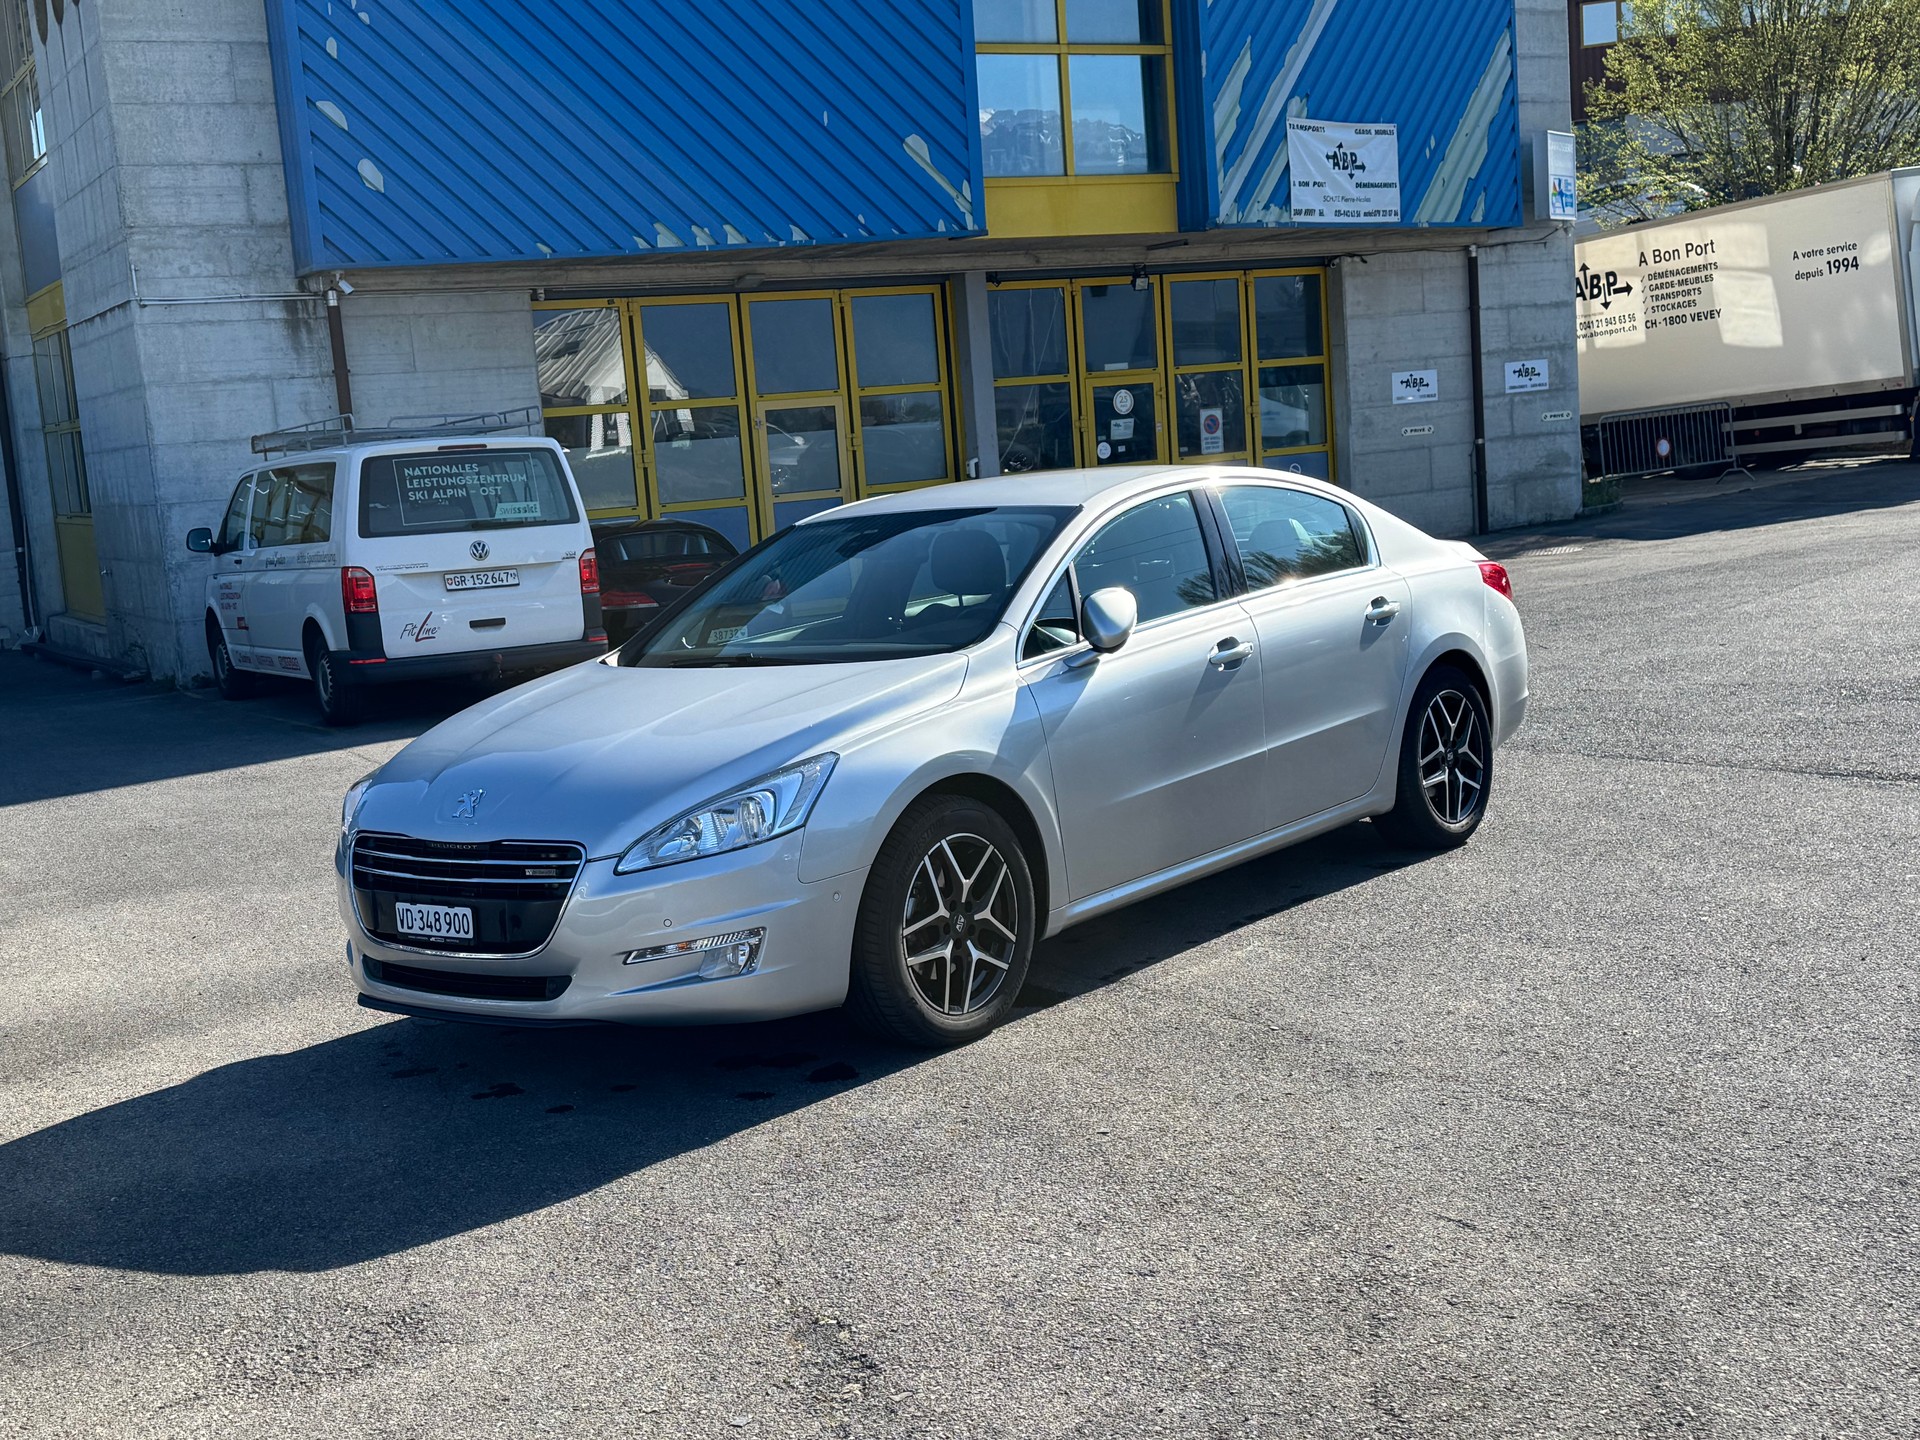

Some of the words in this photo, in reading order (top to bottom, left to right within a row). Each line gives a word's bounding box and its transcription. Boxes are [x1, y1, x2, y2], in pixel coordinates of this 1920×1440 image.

[1332, 151, 1358, 170] ABP
[1639, 251, 1648, 267] A
[1652, 248, 1680, 264] Bon
[1685, 239, 1715, 258] Port
[1793, 251, 1799, 261] A
[1801, 249, 1824, 259] votre
[1826, 241, 1857, 254] service
[1648, 262, 1718, 281] DÉMÉNAGEMENTS
[1795, 267, 1824, 281] depuis
[1826, 256, 1859, 275] 1994
[1648, 274, 1714, 292] GARDE-MEUBLES
[1650, 287, 1702, 302] TRANSPORTS
[1651, 299, 1697, 313] STOCKAGES
[1596, 318, 1603, 328] 21
[1605, 316, 1616, 327] 943
[1618, 314, 1626, 324] 63
[1690, 308, 1722, 322] VEVEY
[404, 464, 479, 476] NATIONALES
[406, 474, 527, 488] LEISTUNGSZENTRUM
[408, 491, 428, 501] SKI
[432, 488, 467, 499] ALPIN
[480, 486, 502, 496] OST
